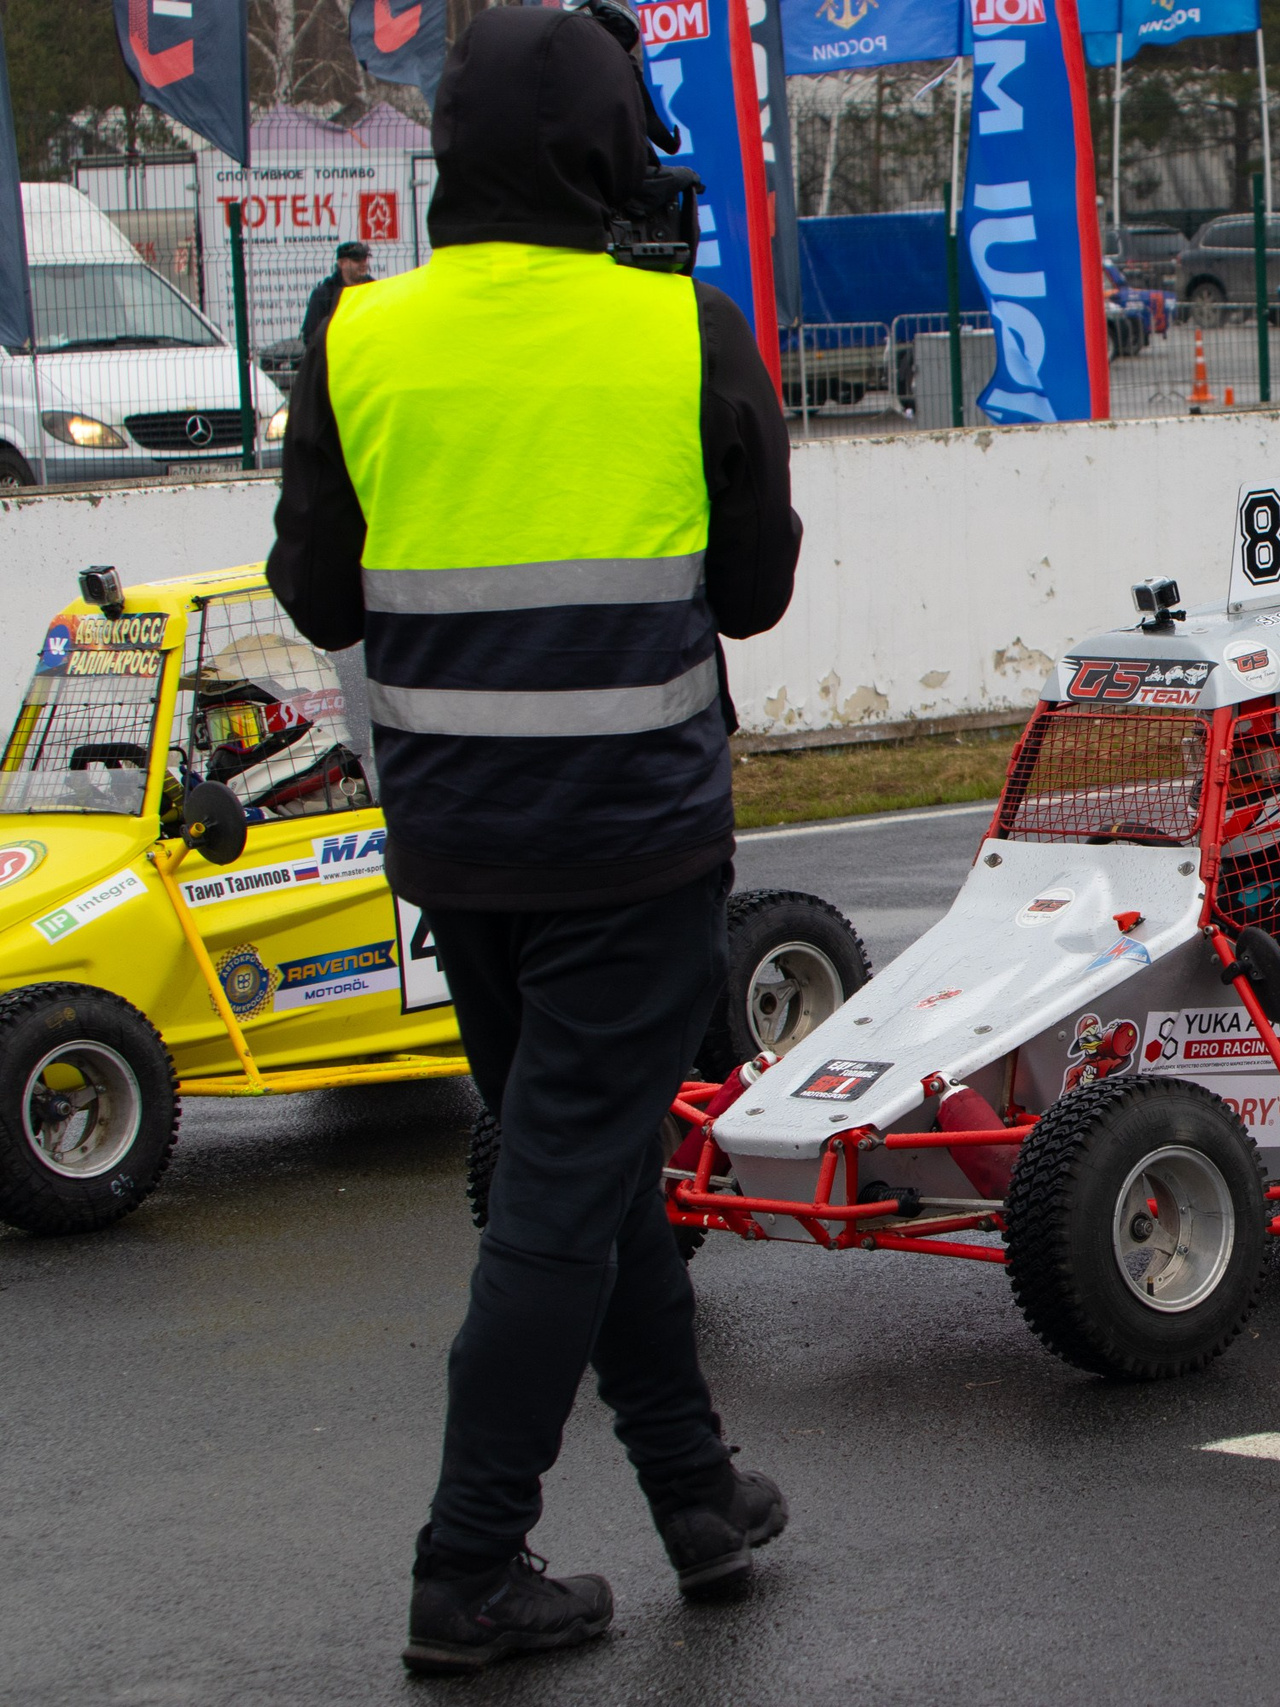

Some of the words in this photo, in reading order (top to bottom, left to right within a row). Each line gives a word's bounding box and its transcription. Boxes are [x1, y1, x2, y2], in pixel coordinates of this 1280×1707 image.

[315, 167, 376, 180] ТОПЛИВО
[216, 193, 336, 229] ТОТЕК
[1139, 688, 1201, 704] TEAM
[185, 881, 225, 903] Таир
[225, 868, 291, 894] Талипов
[44, 913, 69, 932] IP
[76, 876, 138, 912] integra
[287, 948, 387, 983] RAVENOL
[305, 978, 370, 1000] MOTORÖL
[1185, 1012, 1241, 1034] YUKA
[1191, 1043, 1220, 1056] PRO
[1223, 1040, 1271, 1055] RACIN
